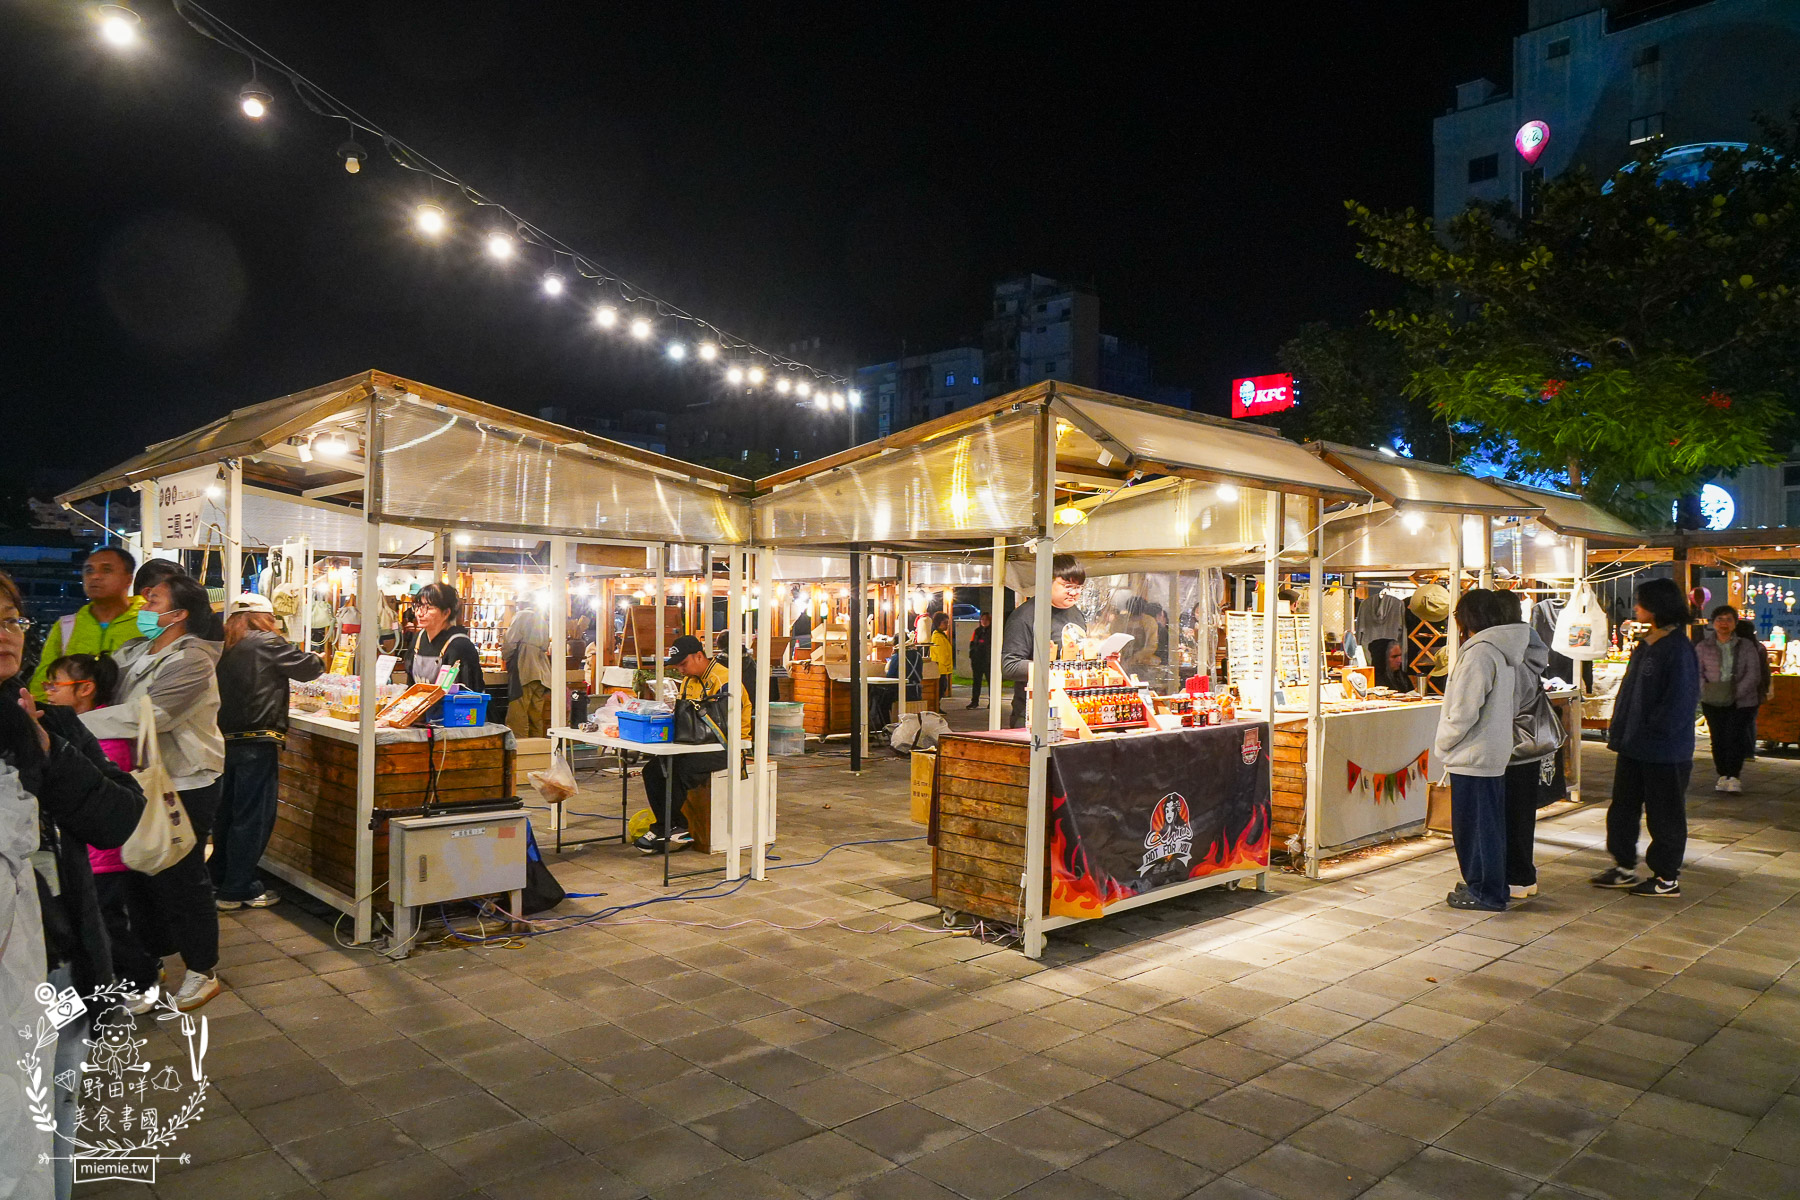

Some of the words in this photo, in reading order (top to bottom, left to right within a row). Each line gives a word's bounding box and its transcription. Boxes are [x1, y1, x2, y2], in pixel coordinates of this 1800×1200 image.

[1255, 387, 1287, 403] KFC
[1145, 848, 1159, 864] HOT
[1162, 843, 1177, 856] FOR
[1179, 843, 1190, 854] YOU
